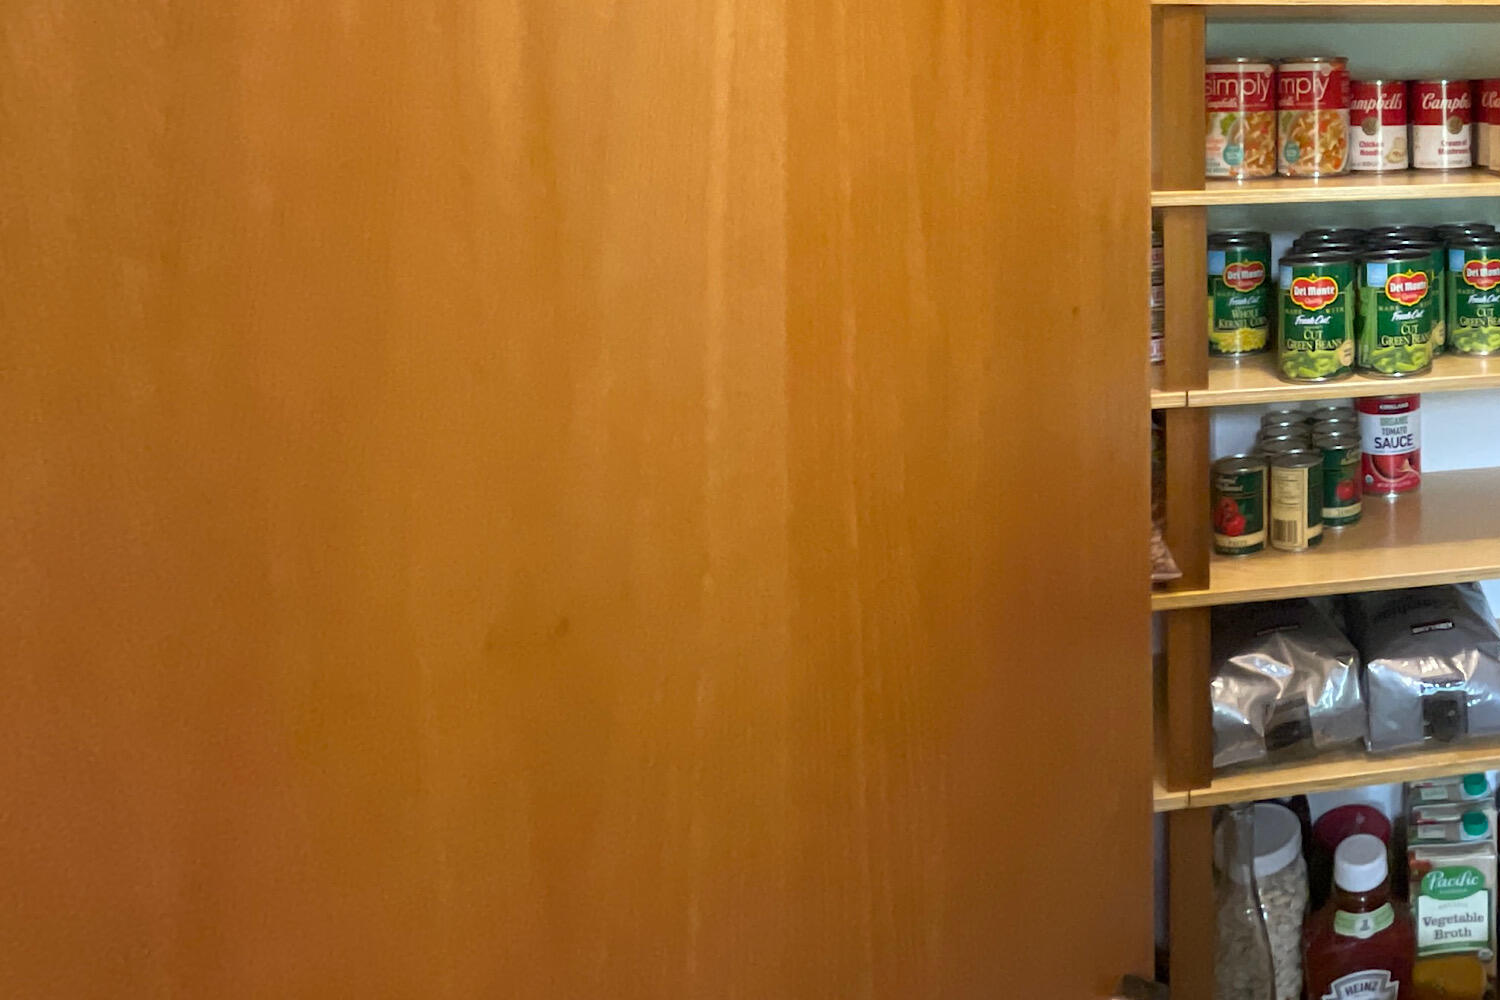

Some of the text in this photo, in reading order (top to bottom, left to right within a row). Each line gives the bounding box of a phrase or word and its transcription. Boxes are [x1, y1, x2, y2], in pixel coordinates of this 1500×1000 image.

[1280, 75, 1330, 101] mply
[1467, 268, 1478, 277] Del
[1294, 286, 1334, 296] Del Monte
[1390, 281, 1426, 292] Del Monte
[1477, 307, 1493, 317] CUT
[1460, 316, 1486, 326] GREEN
[1304, 329, 1323, 340] CUT
[1401, 324, 1418, 335] CUT
[1287, 339, 1313, 350] GREEN
[1381, 333, 1431, 346] GREEN BEAN
[1374, 434, 1414, 449] SAUCE
[1427, 870, 1479, 891] Pacific
[1422, 912, 1484, 928] Vegetable
[1434, 927, 1472, 940] Broth
[1344, 981, 1379, 996] HEINZ
